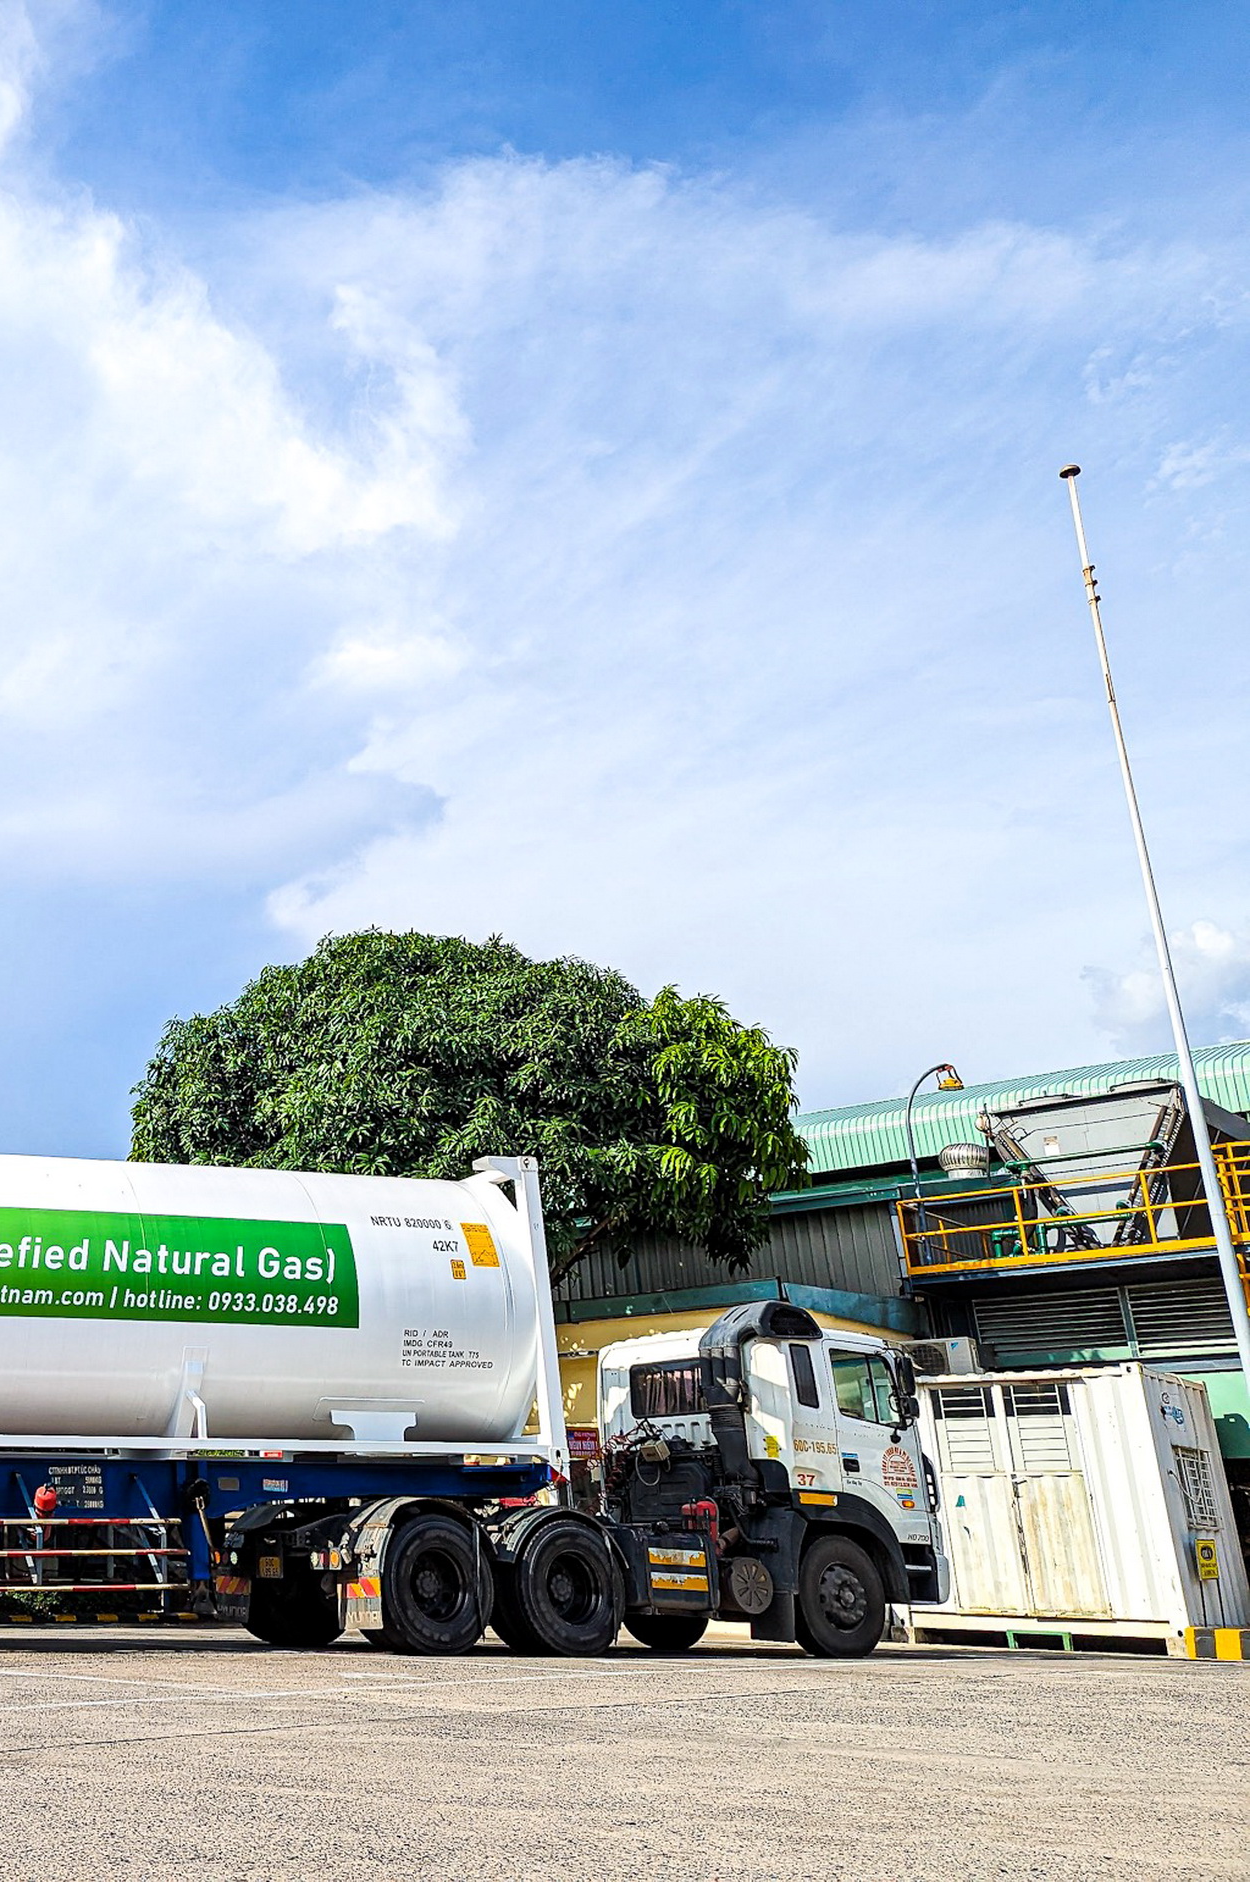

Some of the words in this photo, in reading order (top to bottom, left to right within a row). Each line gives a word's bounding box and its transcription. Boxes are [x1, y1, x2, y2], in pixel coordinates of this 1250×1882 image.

[370, 1216, 401, 1227] NRTU
[403, 1217, 442, 1230] 820000
[432, 1240, 458, 1252] 42K7
[102, 1239, 245, 1277] Natural
[258, 1247, 335, 1285] Gas)
[123, 1289, 203, 1310] hotline:
[208, 1291, 339, 1316] 0933.038.498
[404, 1329, 418, 1337] RID
[432, 1330, 449, 1338] ADR
[403, 1339, 423, 1347] IMDG
[414, 1359, 446, 1367] IMPACT
[448, 1360, 493, 1369] APPROVED
[797, 1473, 816, 1486] 37
